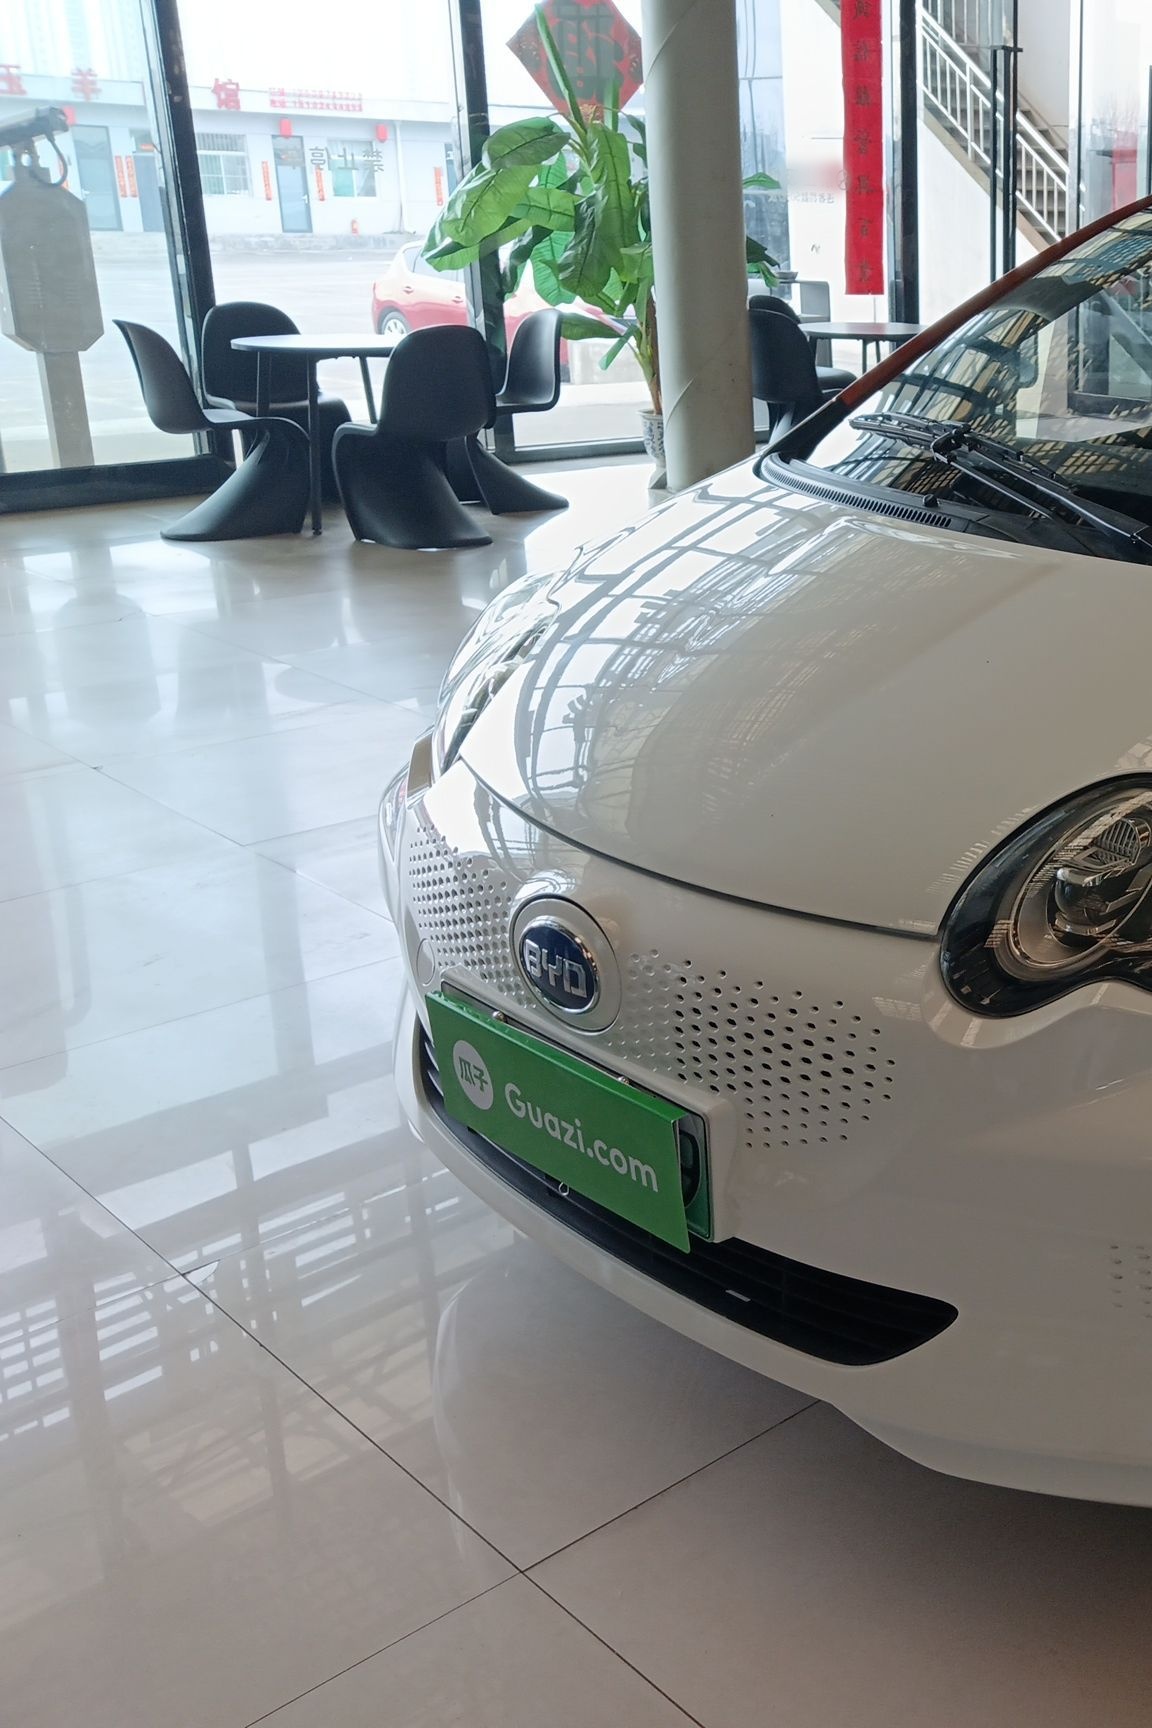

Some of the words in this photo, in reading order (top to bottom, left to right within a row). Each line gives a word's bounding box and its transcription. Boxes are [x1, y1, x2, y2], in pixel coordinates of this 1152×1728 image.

[523, 938, 587, 998] BYD
[458, 1056, 489, 1092] 瓜子
[504, 1083, 659, 1193] Guazi.com
